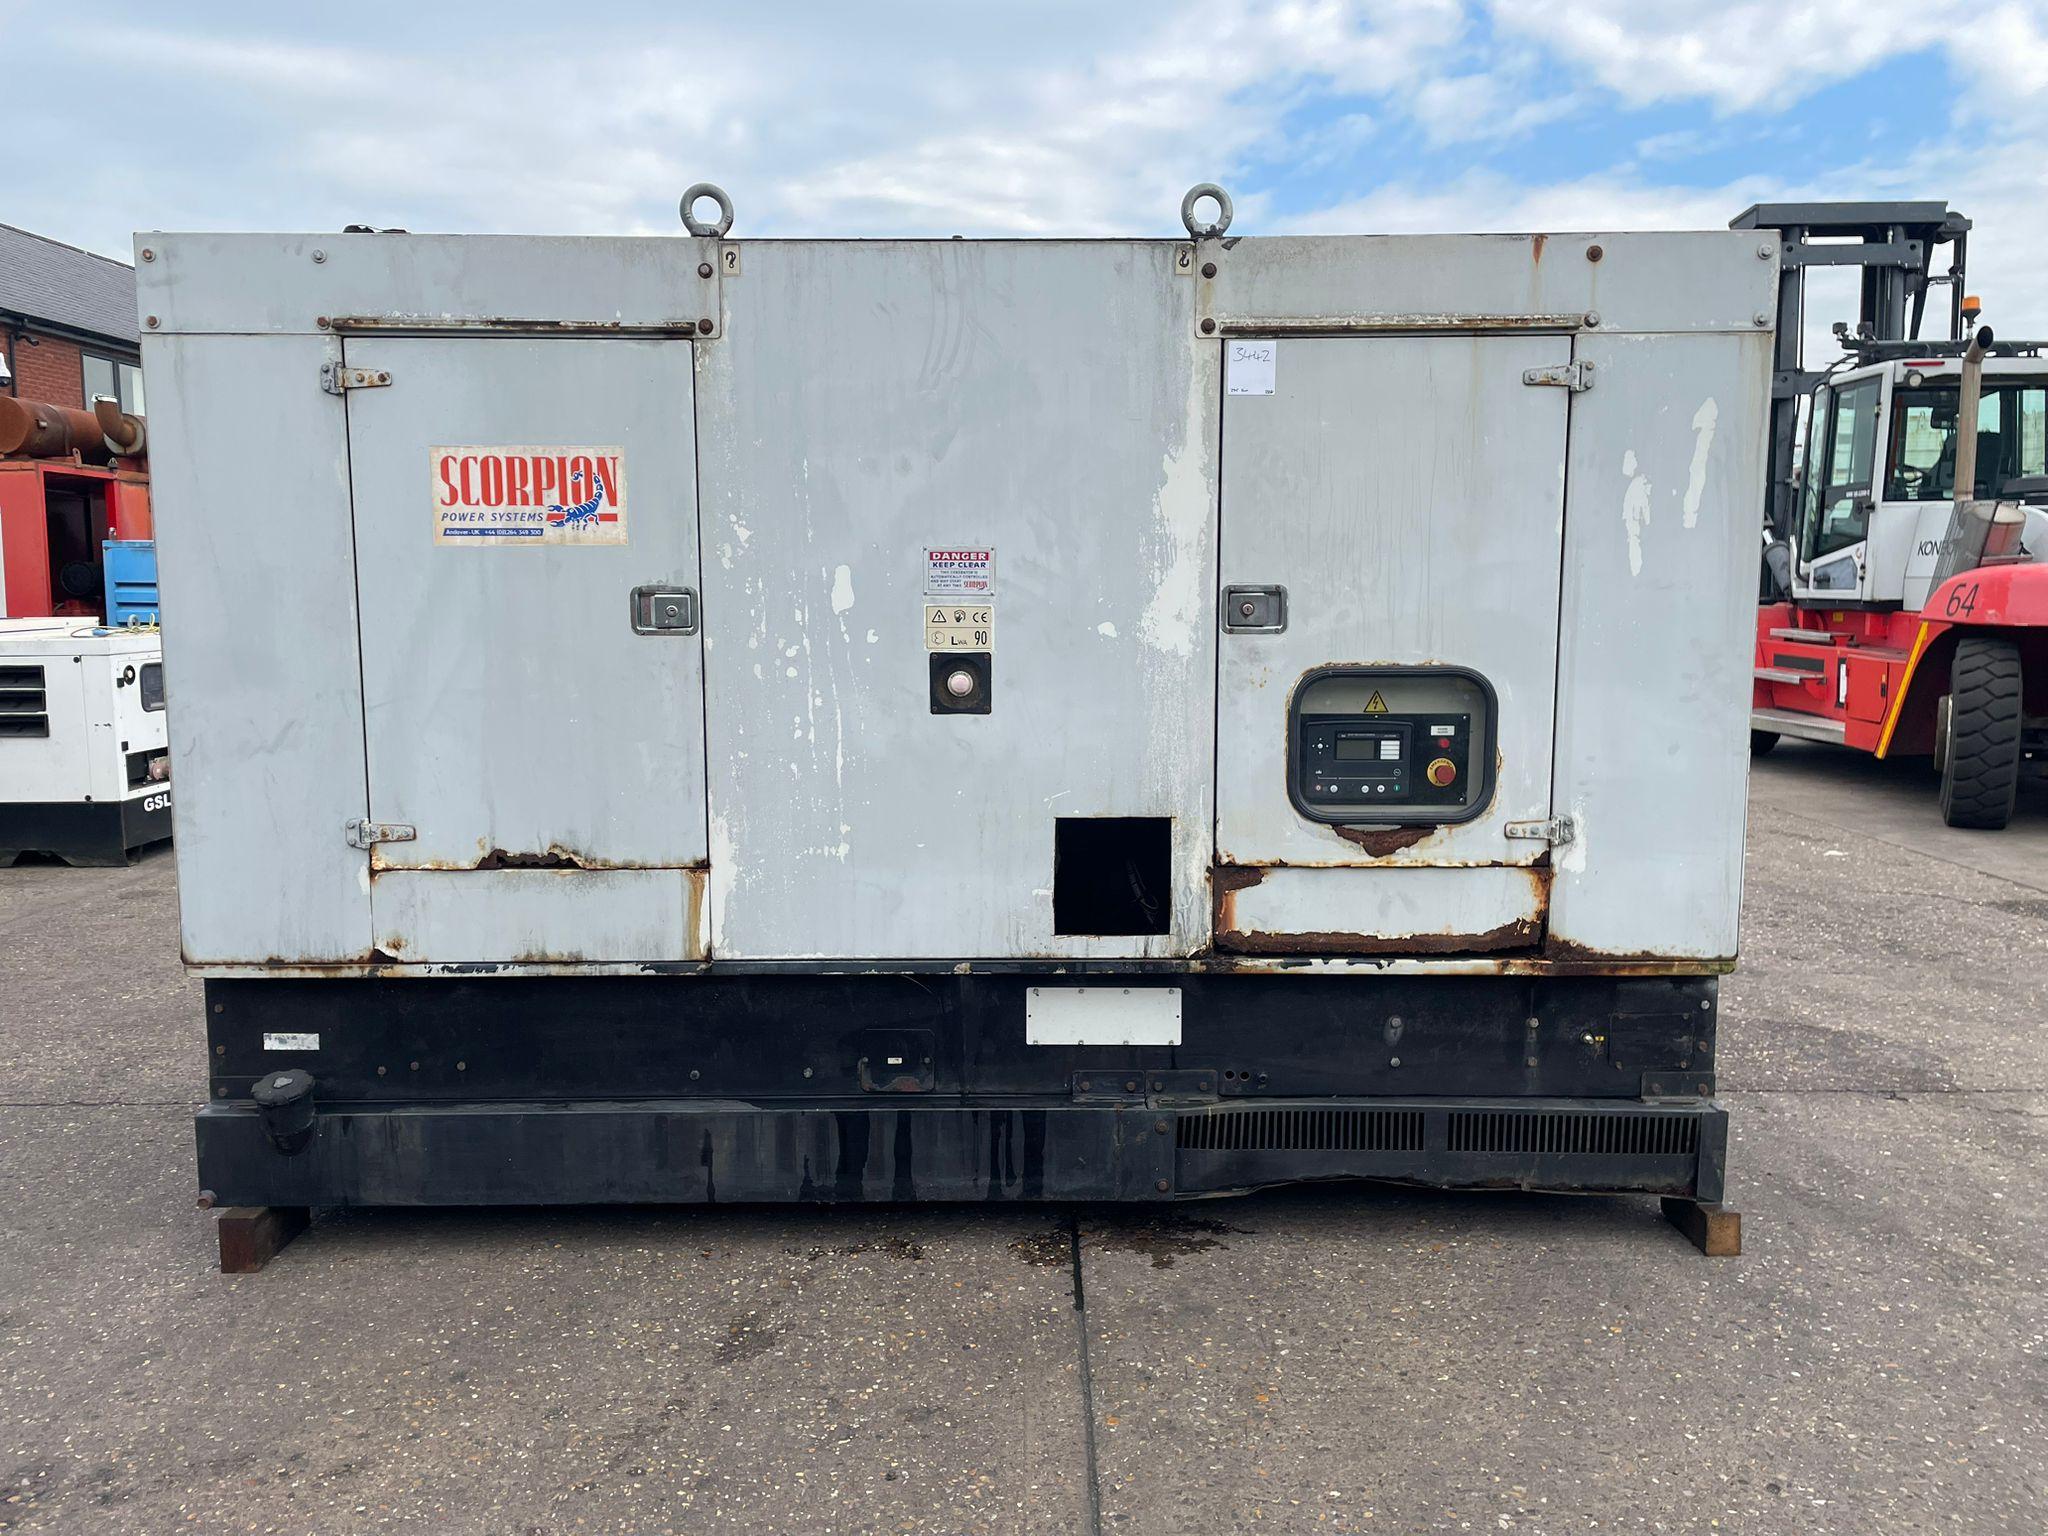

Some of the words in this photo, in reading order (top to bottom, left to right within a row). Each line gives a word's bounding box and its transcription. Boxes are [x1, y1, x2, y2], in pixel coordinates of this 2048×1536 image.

[1232, 346, 1271, 362] 3442
[440, 455, 618, 507] SCORPION
[441, 512, 485, 522] POWER
[491, 512, 544, 522] SYSTEMS
[932, 552, 987, 560] DANGER
[1946, 583, 1979, 617] 64
[974, 630, 987, 646] 90
